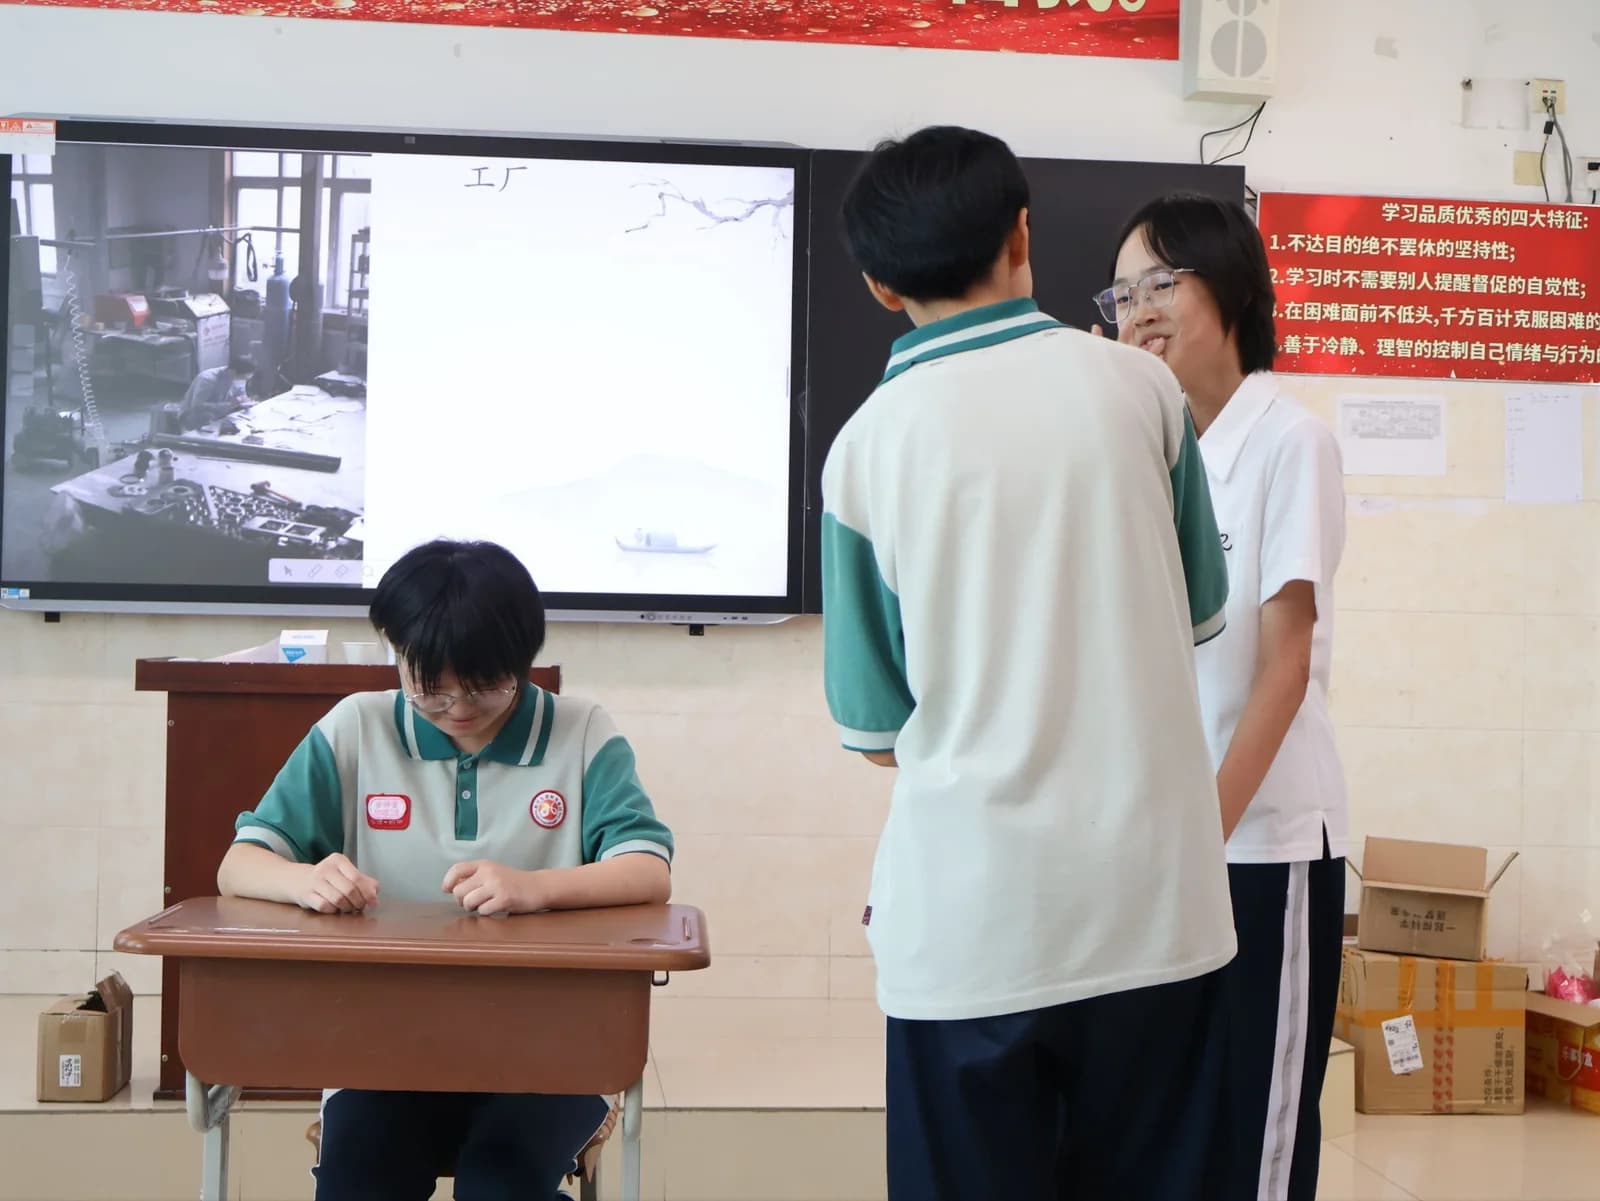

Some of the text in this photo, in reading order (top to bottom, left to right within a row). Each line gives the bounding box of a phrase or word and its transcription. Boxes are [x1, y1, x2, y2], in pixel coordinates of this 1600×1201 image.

[464, 166, 528, 192] 工厂
[1381, 202, 1589, 230] 学习品质优秀的四大特征:
